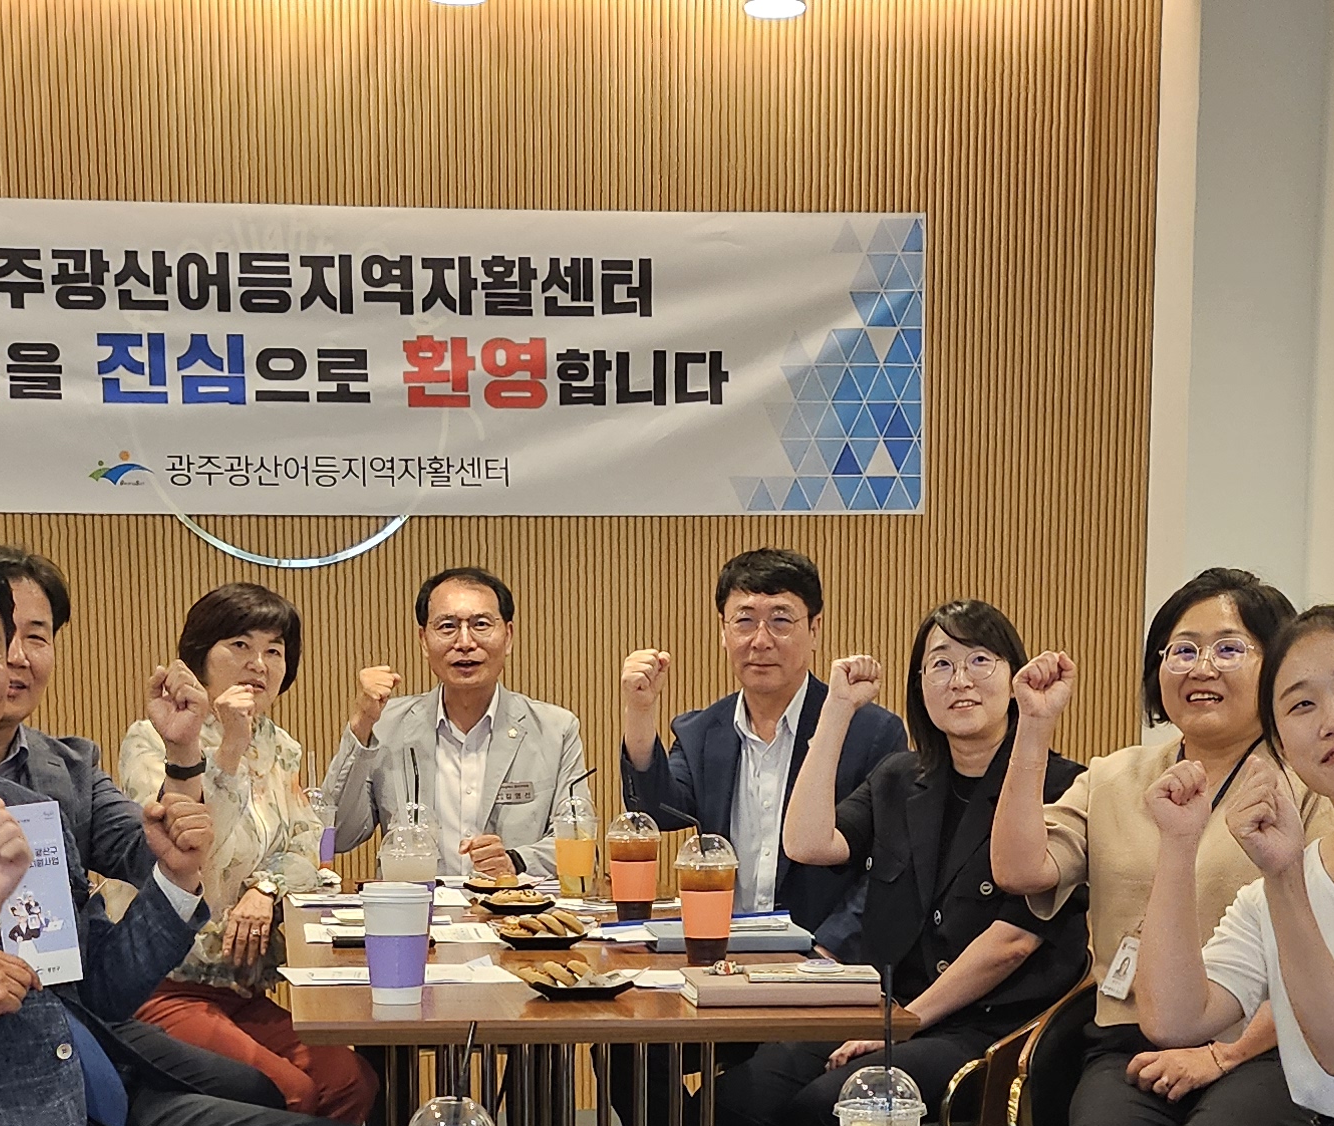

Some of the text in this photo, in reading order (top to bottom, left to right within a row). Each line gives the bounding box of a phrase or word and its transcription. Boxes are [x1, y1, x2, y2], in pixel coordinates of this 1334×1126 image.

[96, 333, 371, 405] 진심으로
[402, 335, 729, 409] 환영합니다
[165, 454, 510, 487] 광주광산어등지역자활센터
